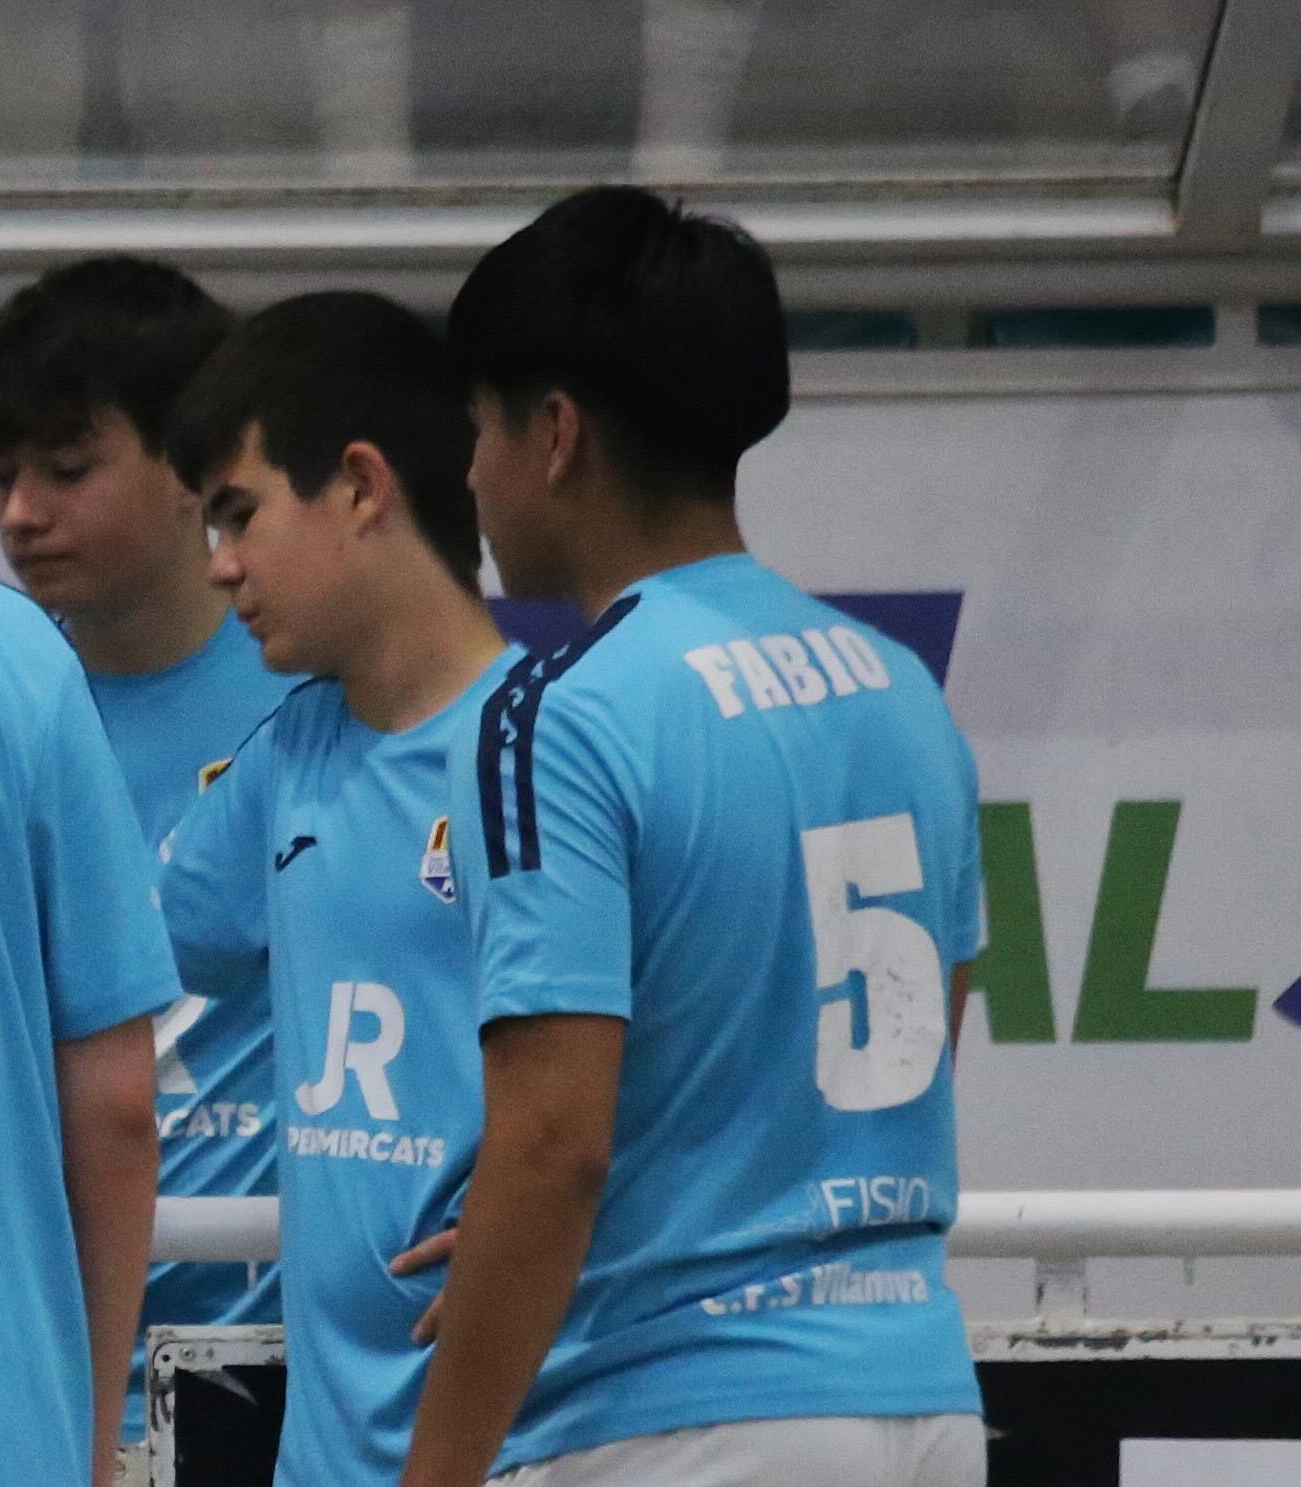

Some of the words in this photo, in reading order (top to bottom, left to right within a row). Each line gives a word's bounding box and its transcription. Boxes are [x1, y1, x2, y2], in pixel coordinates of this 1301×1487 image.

[684, 625, 891, 719] FABIO
[801, 812, 946, 1112] 5
[295, 982, 405, 1120] JR
[821, 1176, 930, 1229] FISIO
